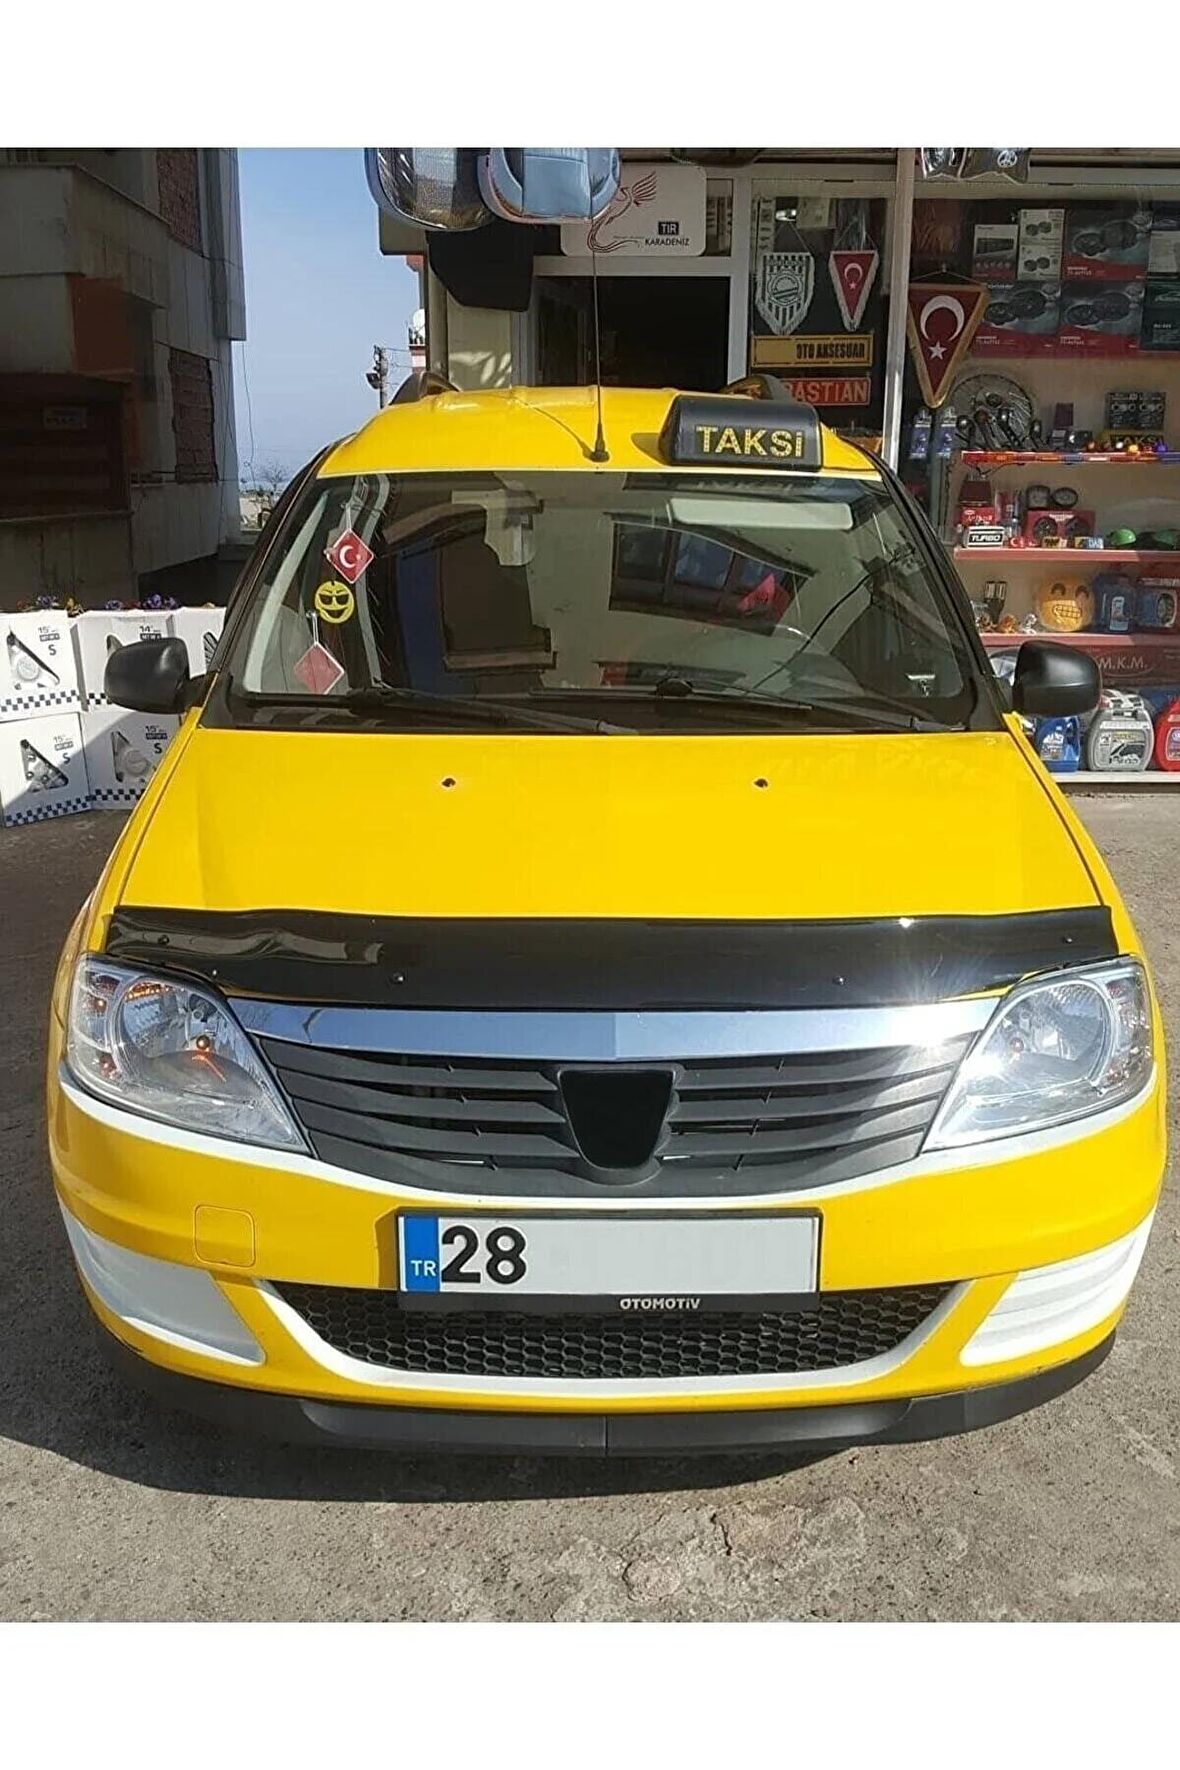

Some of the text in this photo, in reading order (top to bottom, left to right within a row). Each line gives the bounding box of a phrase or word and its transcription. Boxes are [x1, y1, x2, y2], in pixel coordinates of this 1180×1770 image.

[661, 224, 676, 234] TIR
[970, 534, 1001, 542] TURBO
[48, 643, 57, 656] S
[154, 742, 162, 754] S
[62, 752, 71, 765] S
[411, 1225, 526, 1285] TR 28
